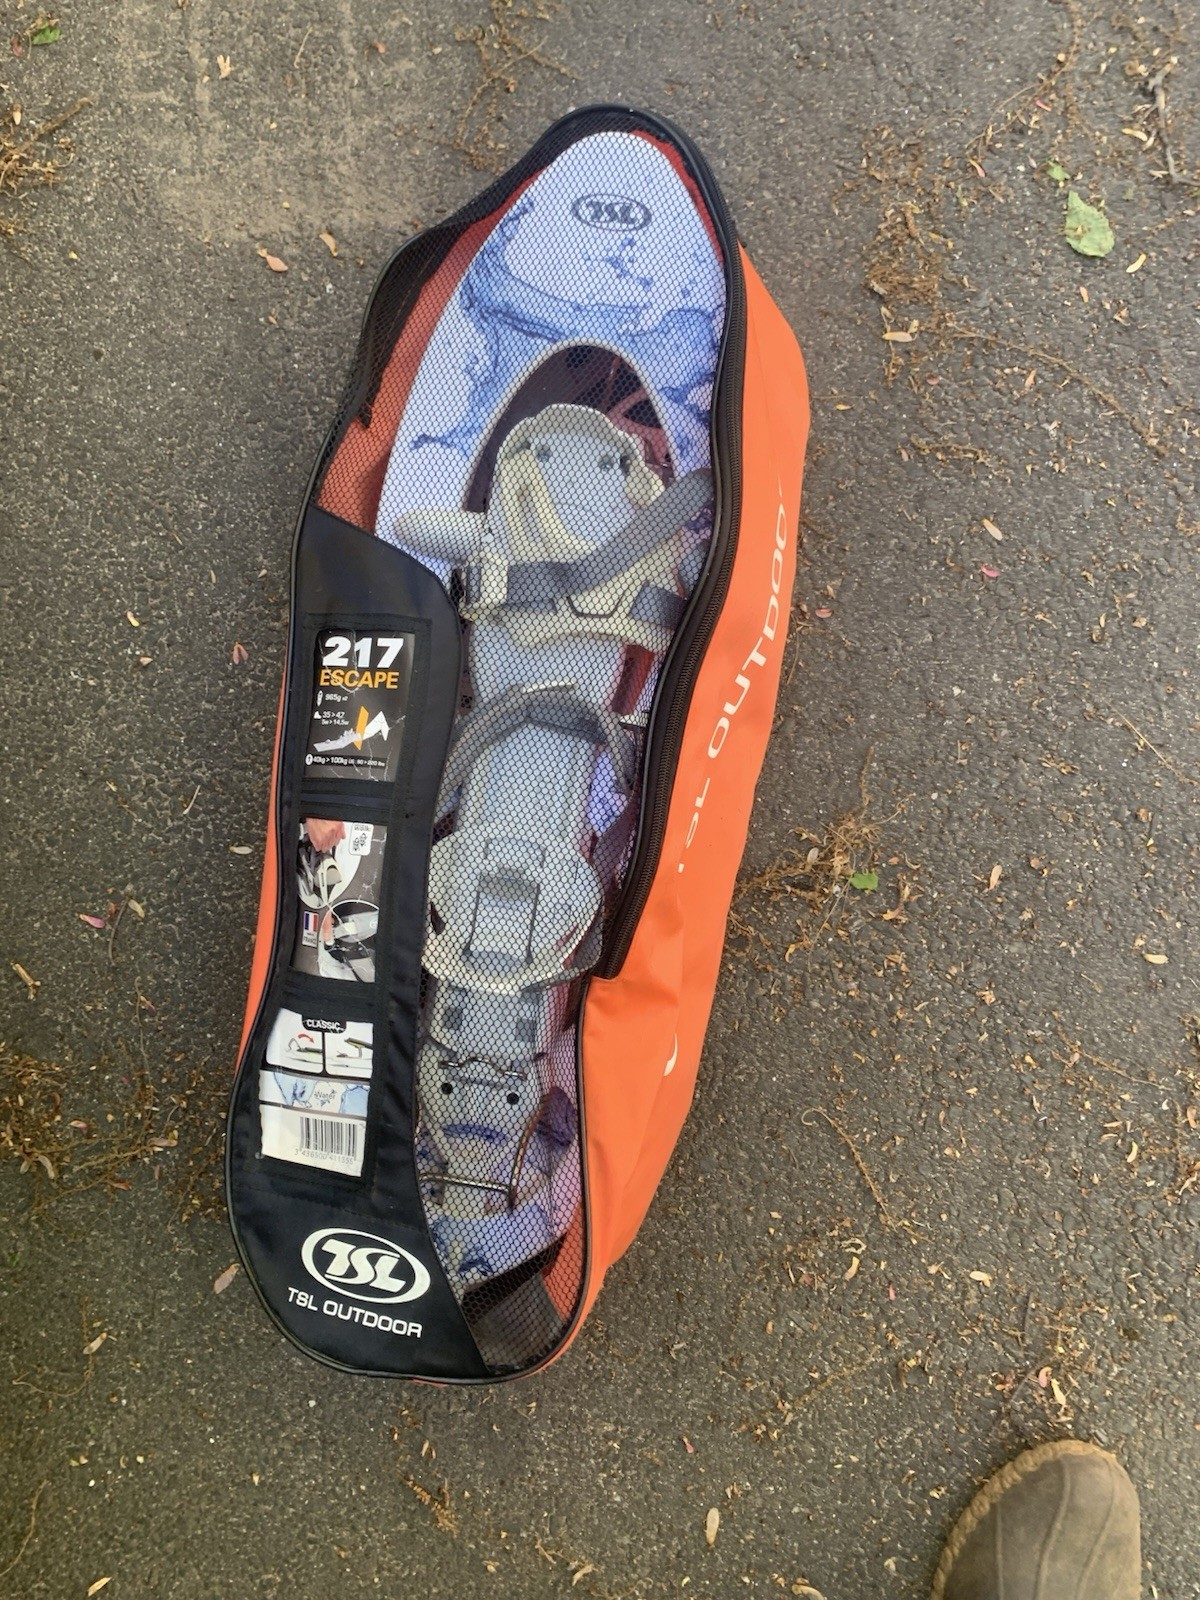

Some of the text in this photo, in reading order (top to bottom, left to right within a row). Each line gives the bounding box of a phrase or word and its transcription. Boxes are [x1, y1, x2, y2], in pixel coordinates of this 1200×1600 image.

[585, 200, 636, 224] TSL
[707, 474, 787, 759] OUTDOO
[322, 636, 404, 668] 217
[319, 669, 399, 689] ESCAPE
[306, 1019, 341, 1030] CLASSIC
[321, 1238, 406, 1293] TSL
[288, 1286, 423, 1338] TSL OUTDOOR
